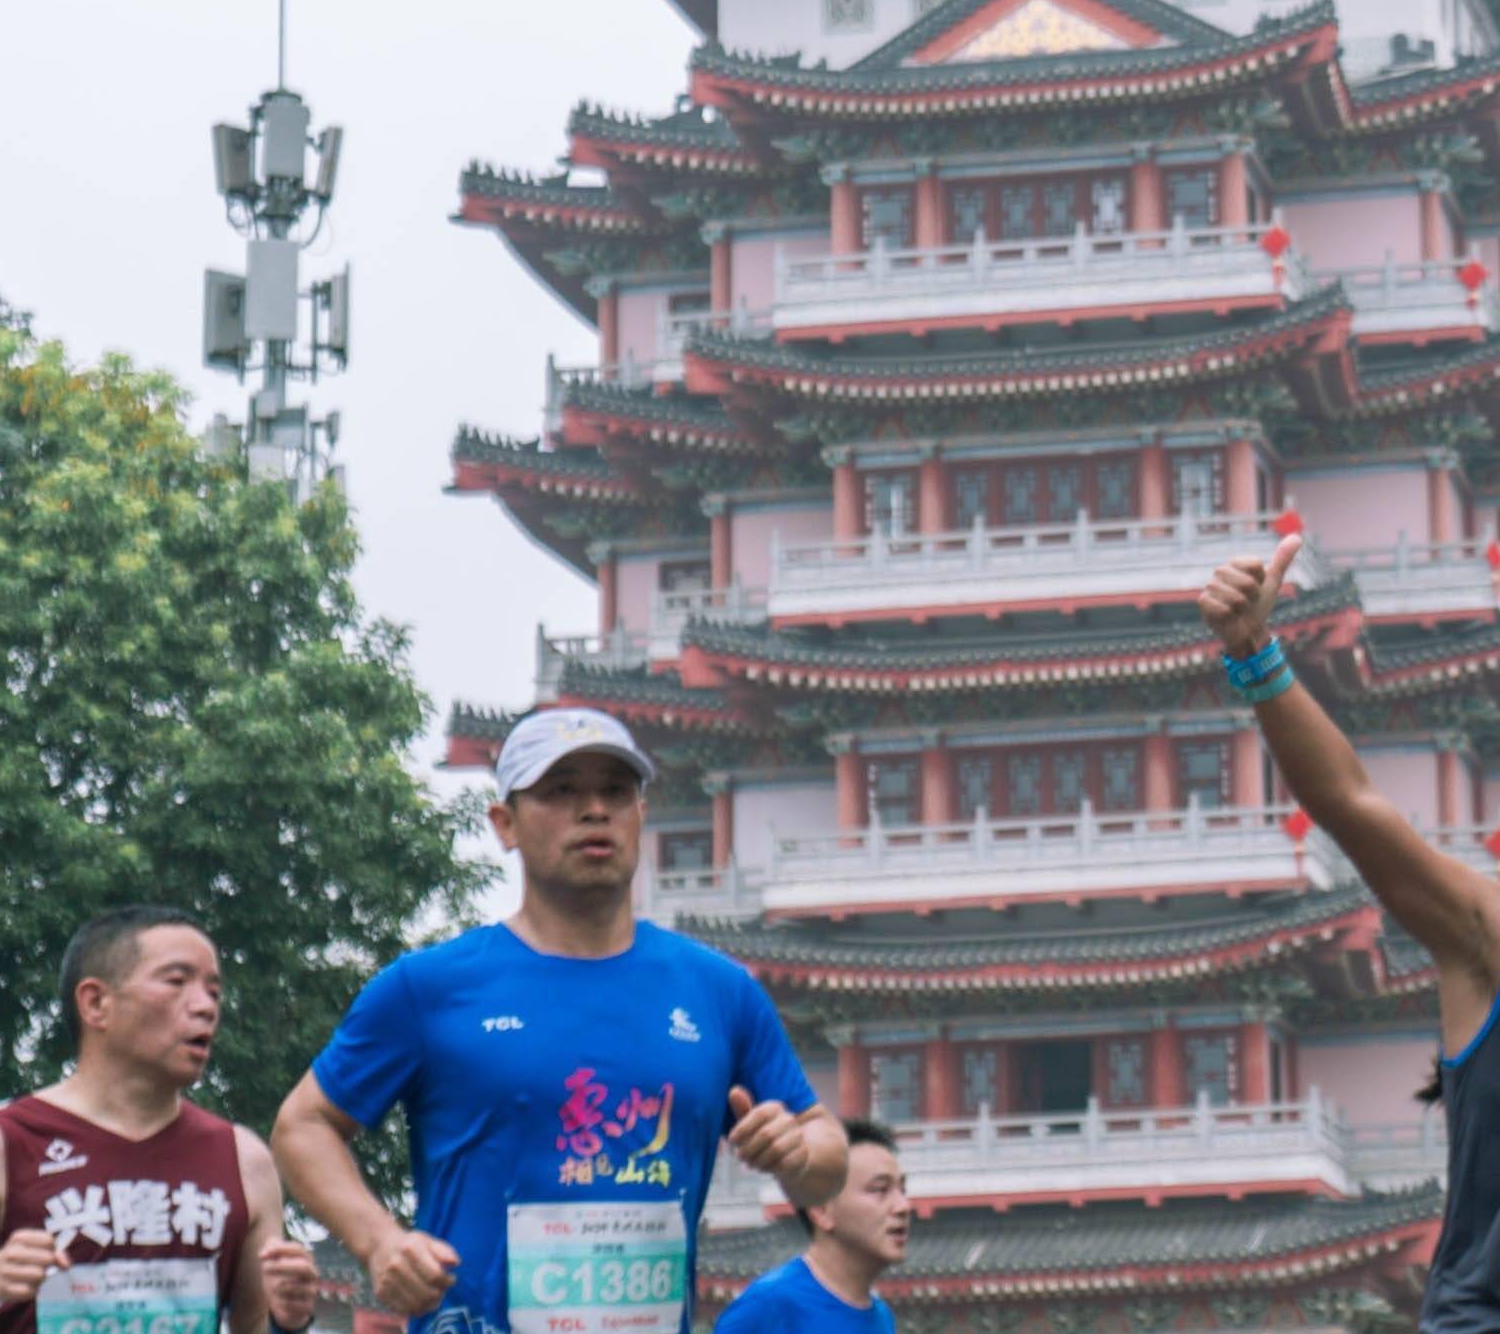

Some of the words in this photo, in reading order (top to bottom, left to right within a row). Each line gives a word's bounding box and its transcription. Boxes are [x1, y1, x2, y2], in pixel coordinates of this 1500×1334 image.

[482, 1015, 525, 1033] TCL
[44, 1179, 232, 1251] 兴隆村
[531, 1261, 673, 1305] C1386
[547, 1318, 586, 1332] TCL
